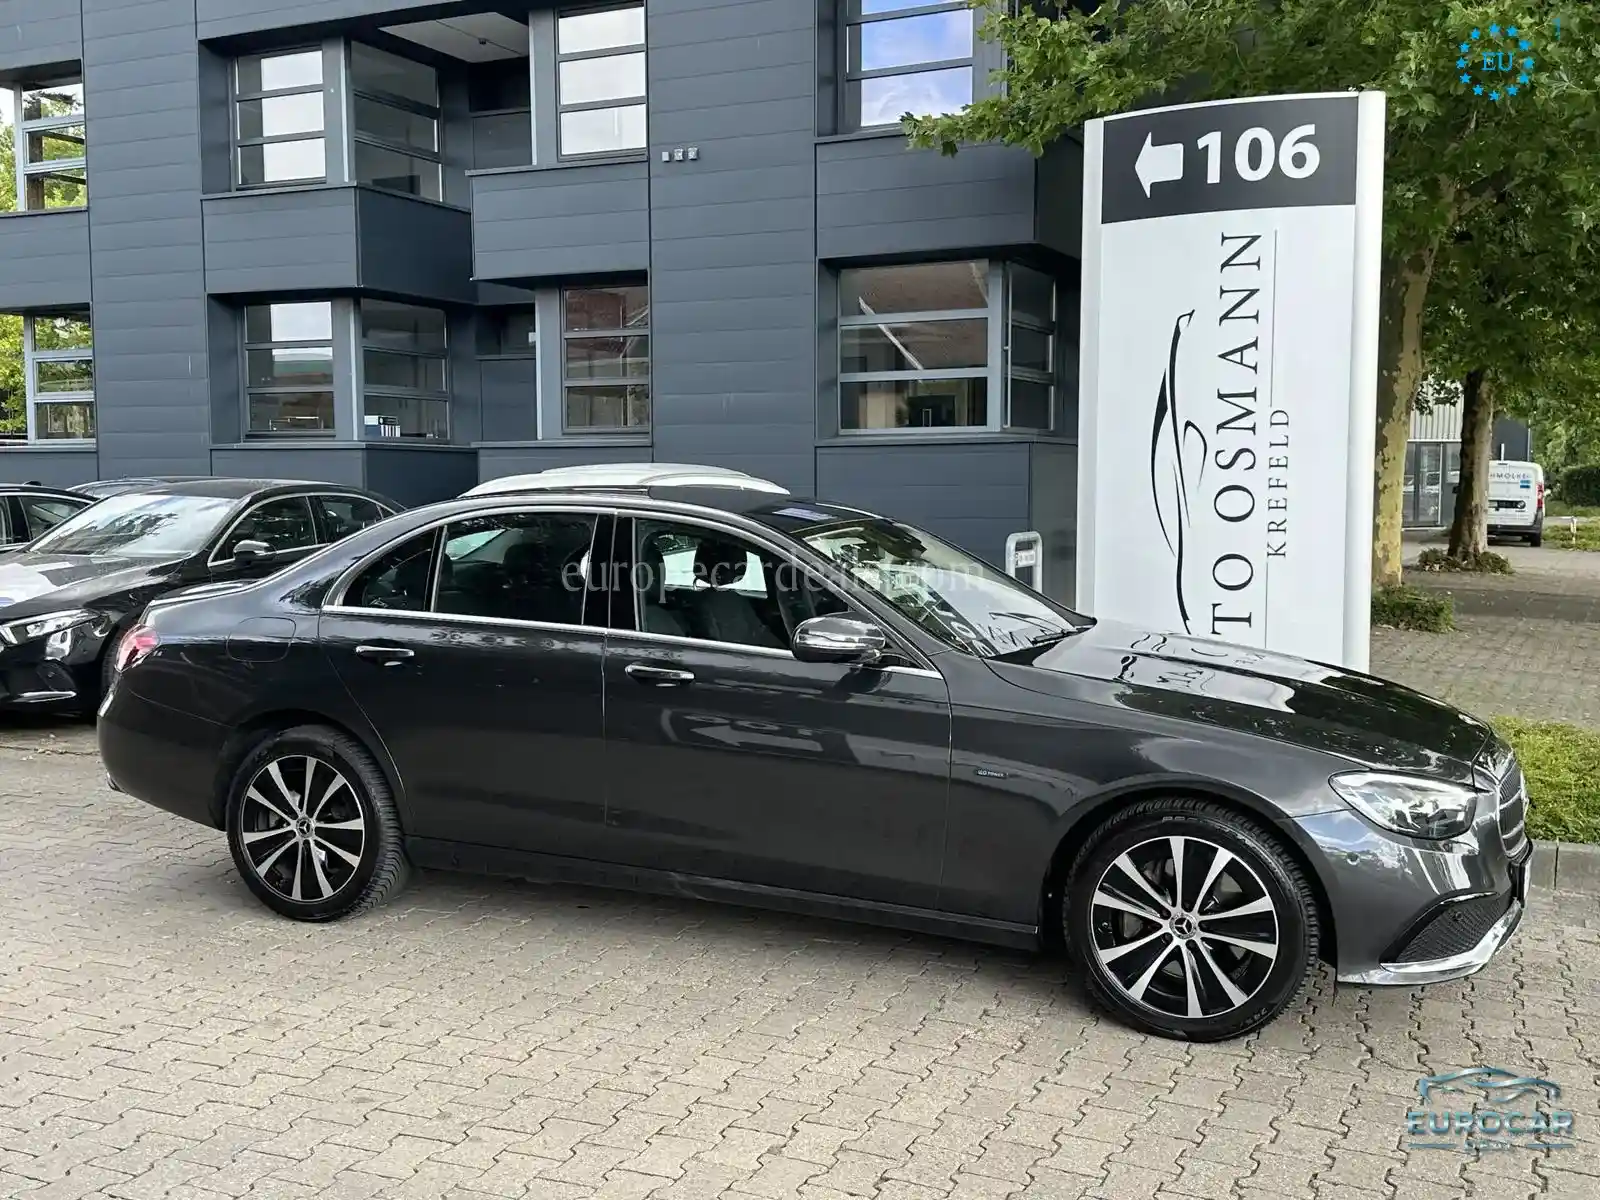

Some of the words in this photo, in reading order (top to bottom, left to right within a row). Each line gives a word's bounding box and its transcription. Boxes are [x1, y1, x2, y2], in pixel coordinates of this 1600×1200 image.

[1196, 123, 1321, 185] 106
[1213, 231, 1263, 523] OSMANN
[1267, 407, 1290, 559] KREFELD
